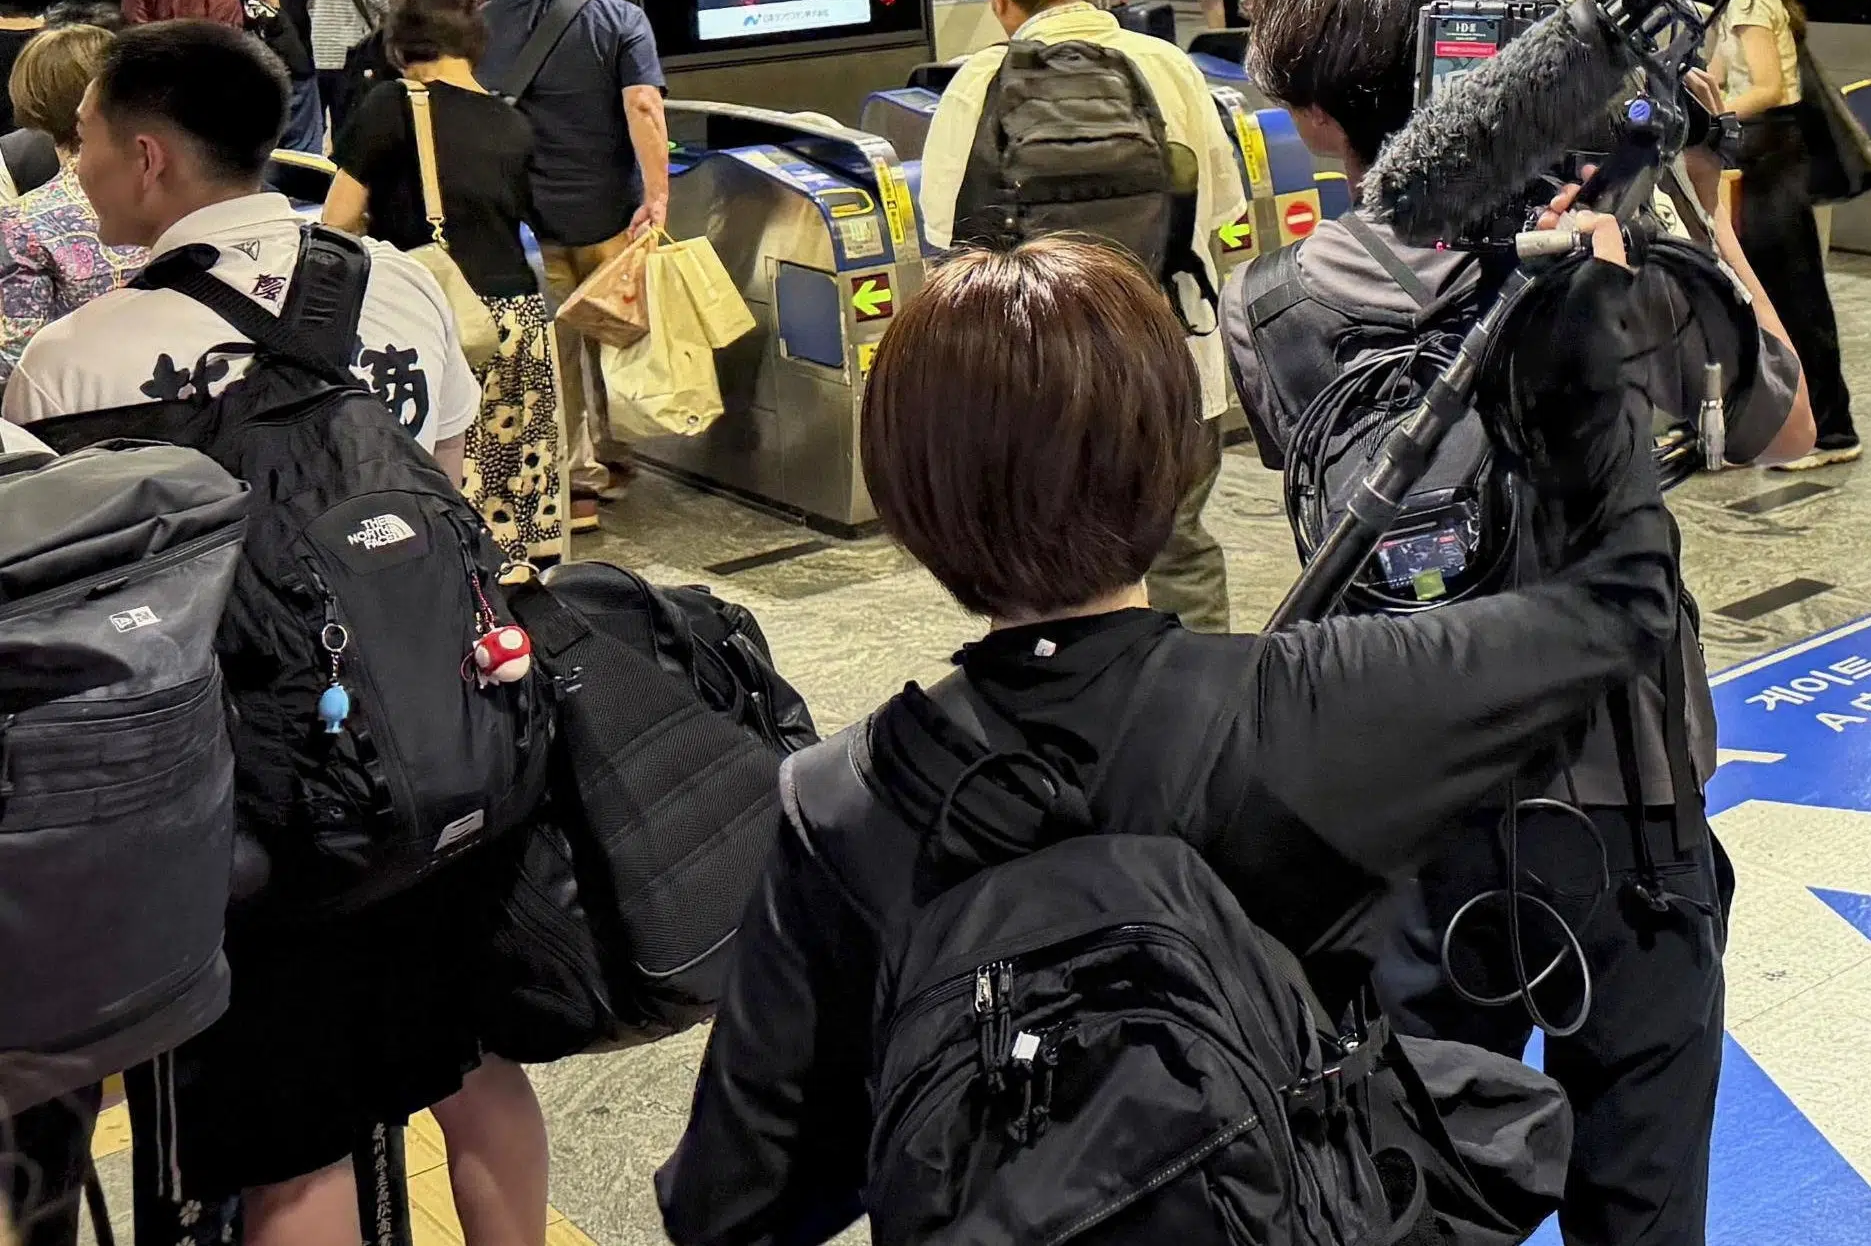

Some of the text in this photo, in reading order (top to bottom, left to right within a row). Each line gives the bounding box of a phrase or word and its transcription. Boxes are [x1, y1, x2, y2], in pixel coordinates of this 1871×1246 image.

[361, 517, 386, 530] THE
[347, 524, 392, 546] NORTH
[364, 534, 396, 550] FACE
